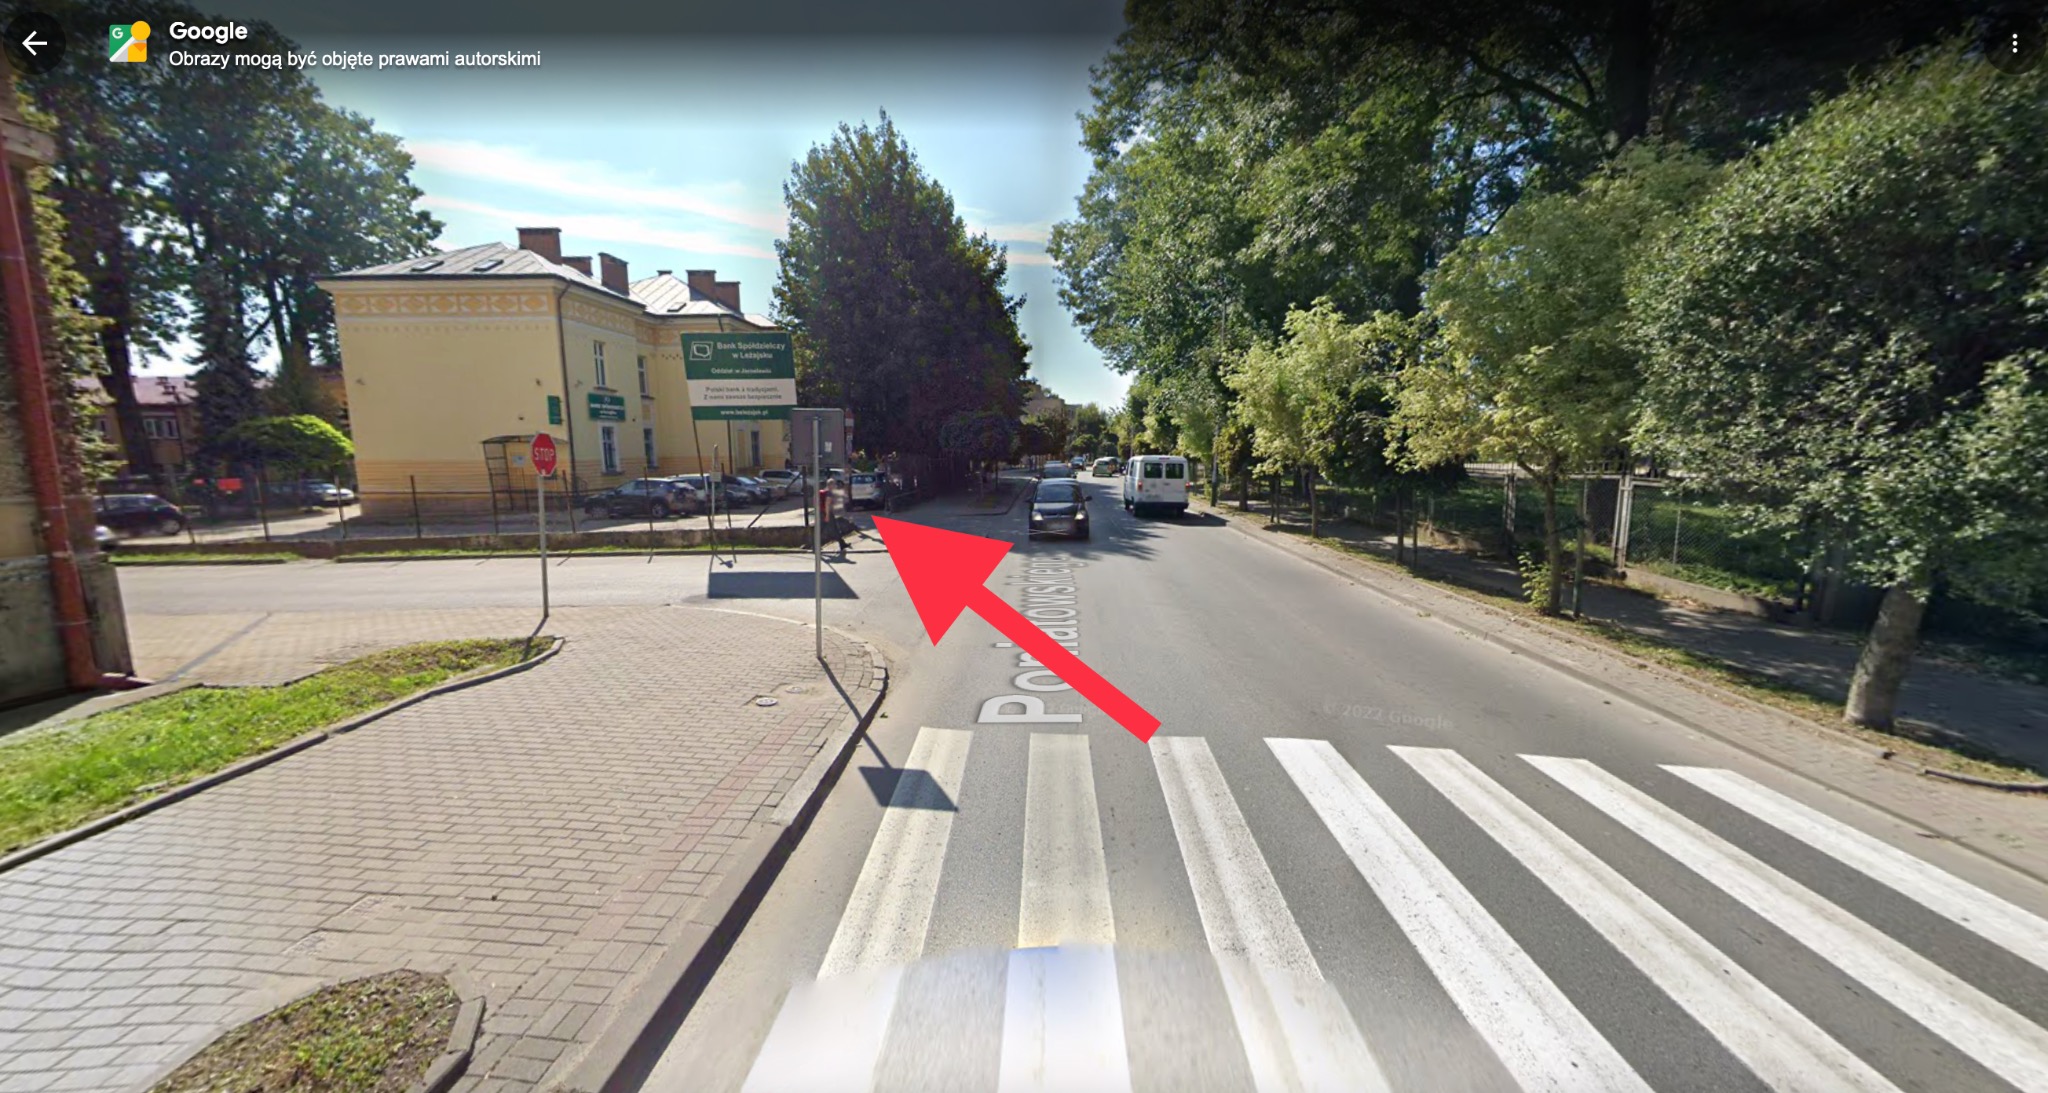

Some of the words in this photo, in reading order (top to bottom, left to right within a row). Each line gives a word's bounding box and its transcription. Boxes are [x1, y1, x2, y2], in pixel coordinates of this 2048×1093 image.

[717, 342, 736, 350] Bank
[737, 342, 785, 350] Spółdzielczy
[740, 352, 772, 360] Leżajsku
[534, 447, 555, 462] STOP
